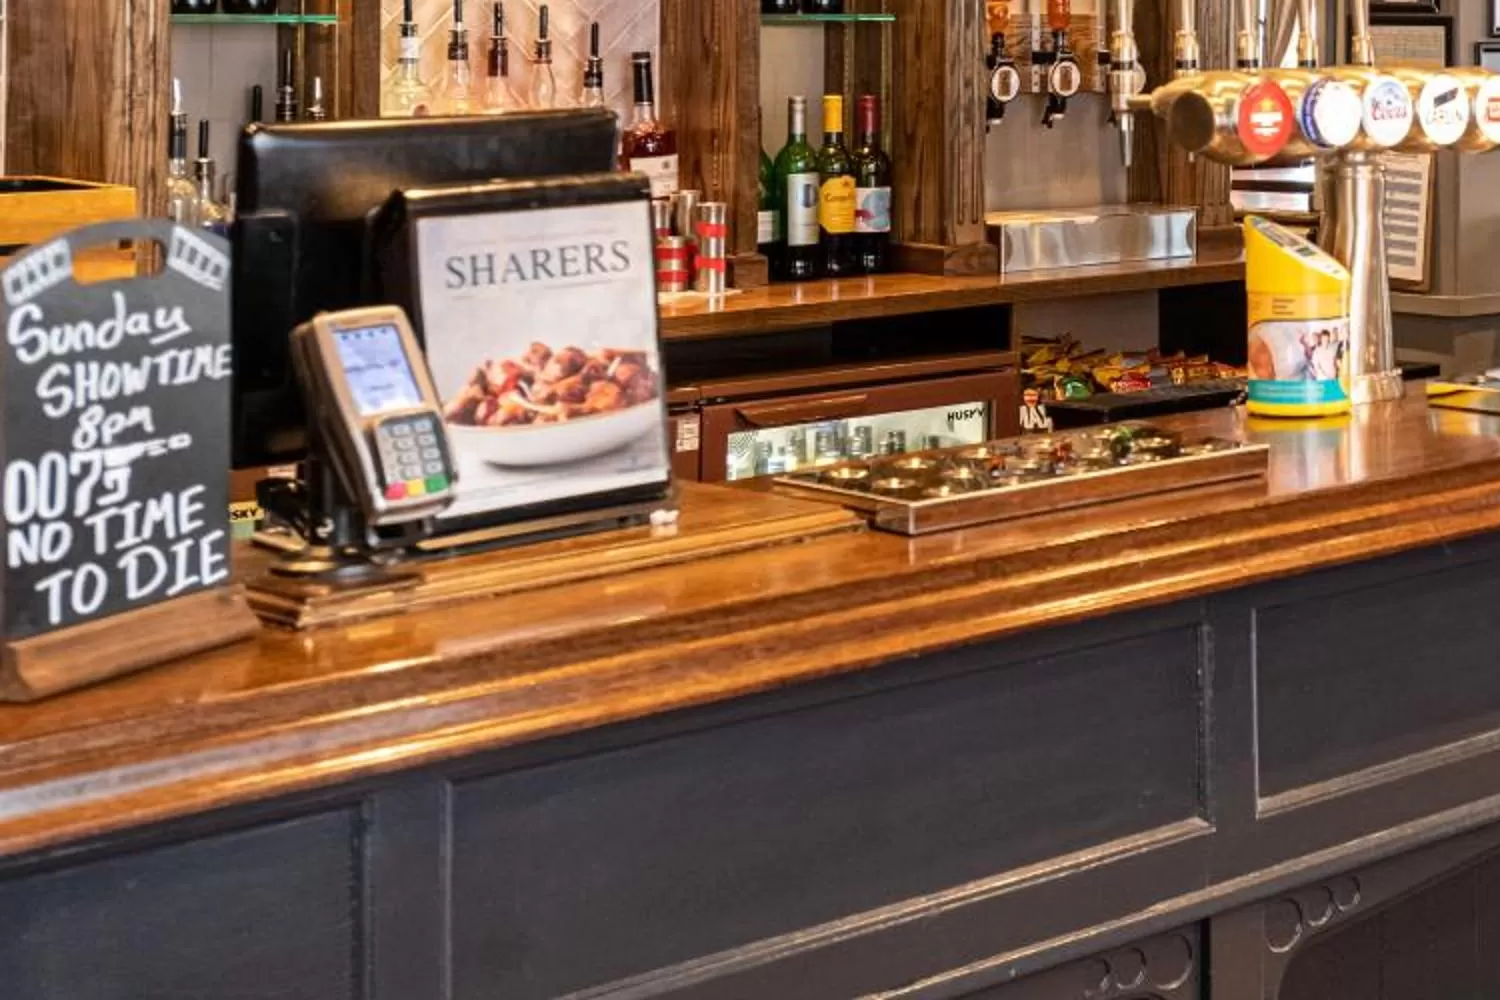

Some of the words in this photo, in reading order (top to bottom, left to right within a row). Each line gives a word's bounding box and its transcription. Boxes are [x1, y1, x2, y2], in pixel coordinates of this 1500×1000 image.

[445, 240, 631, 290] SHARERS
[7, 290, 192, 364] Sunday
[36, 344, 233, 418] SHOWTIME
[8, 521, 72, 568] NO
[84, 484, 206, 555] TIME
[35, 562, 108, 624] TO
[117, 529, 229, 600] DIE
